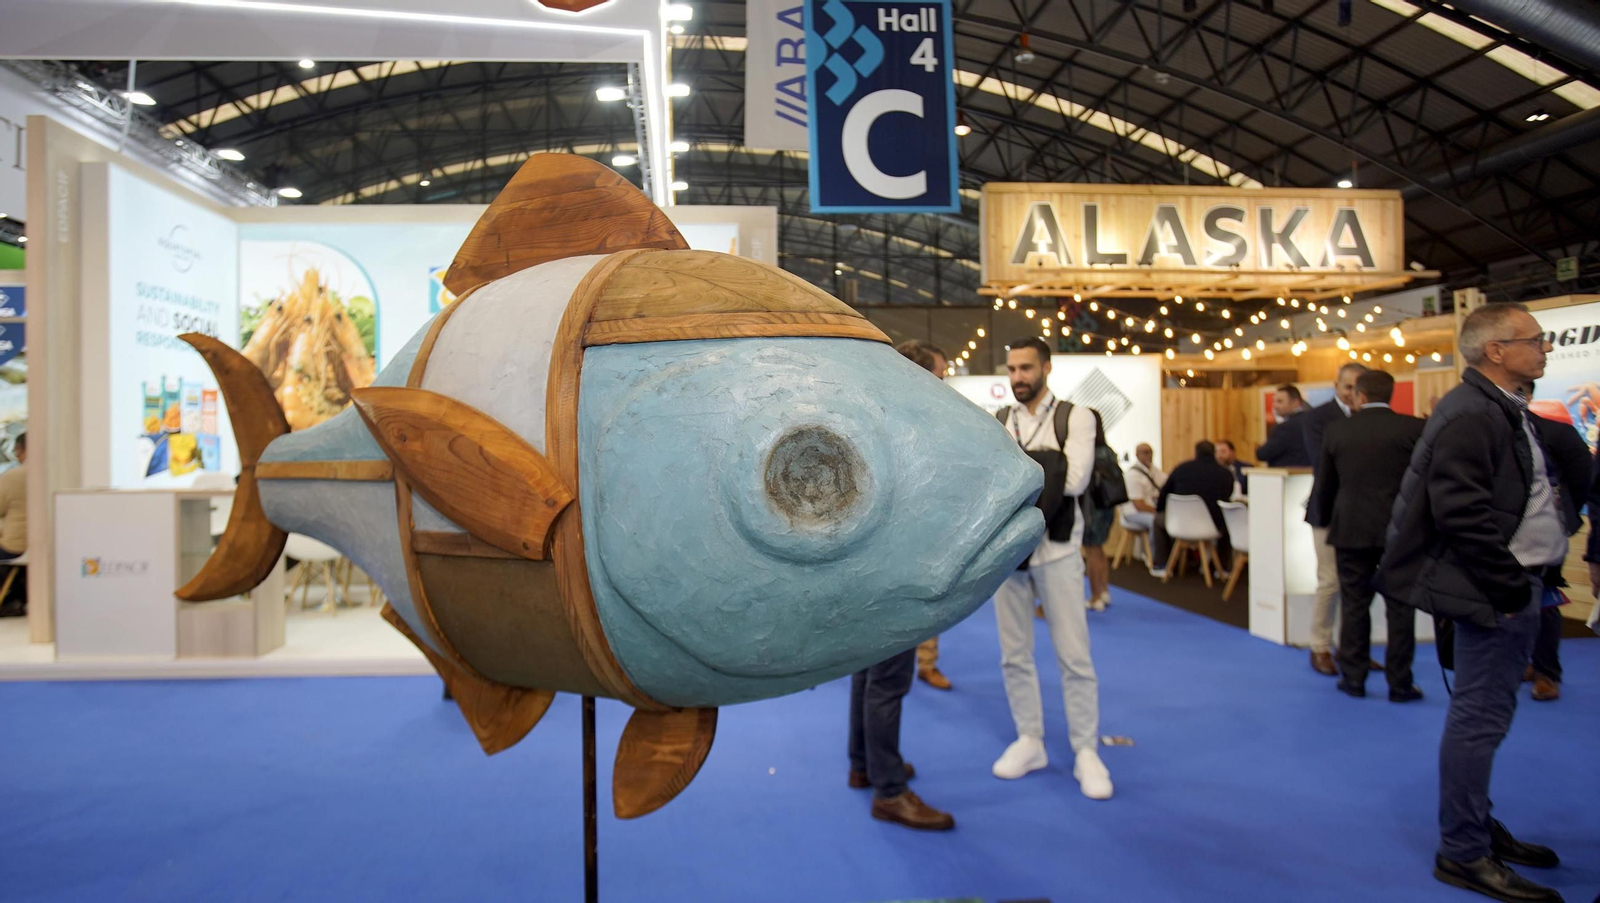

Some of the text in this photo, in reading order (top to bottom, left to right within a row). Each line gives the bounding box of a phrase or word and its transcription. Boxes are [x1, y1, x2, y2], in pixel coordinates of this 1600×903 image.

[877, 7, 937, 32] Hall
[909, 37, 939, 72] 4
[841, 88, 928, 200] C
[1009, 201, 1377, 268] ALASKA
[136, 281, 220, 314] SUSTAINABILITY
[137, 303, 219, 339] AND SOCIAL
